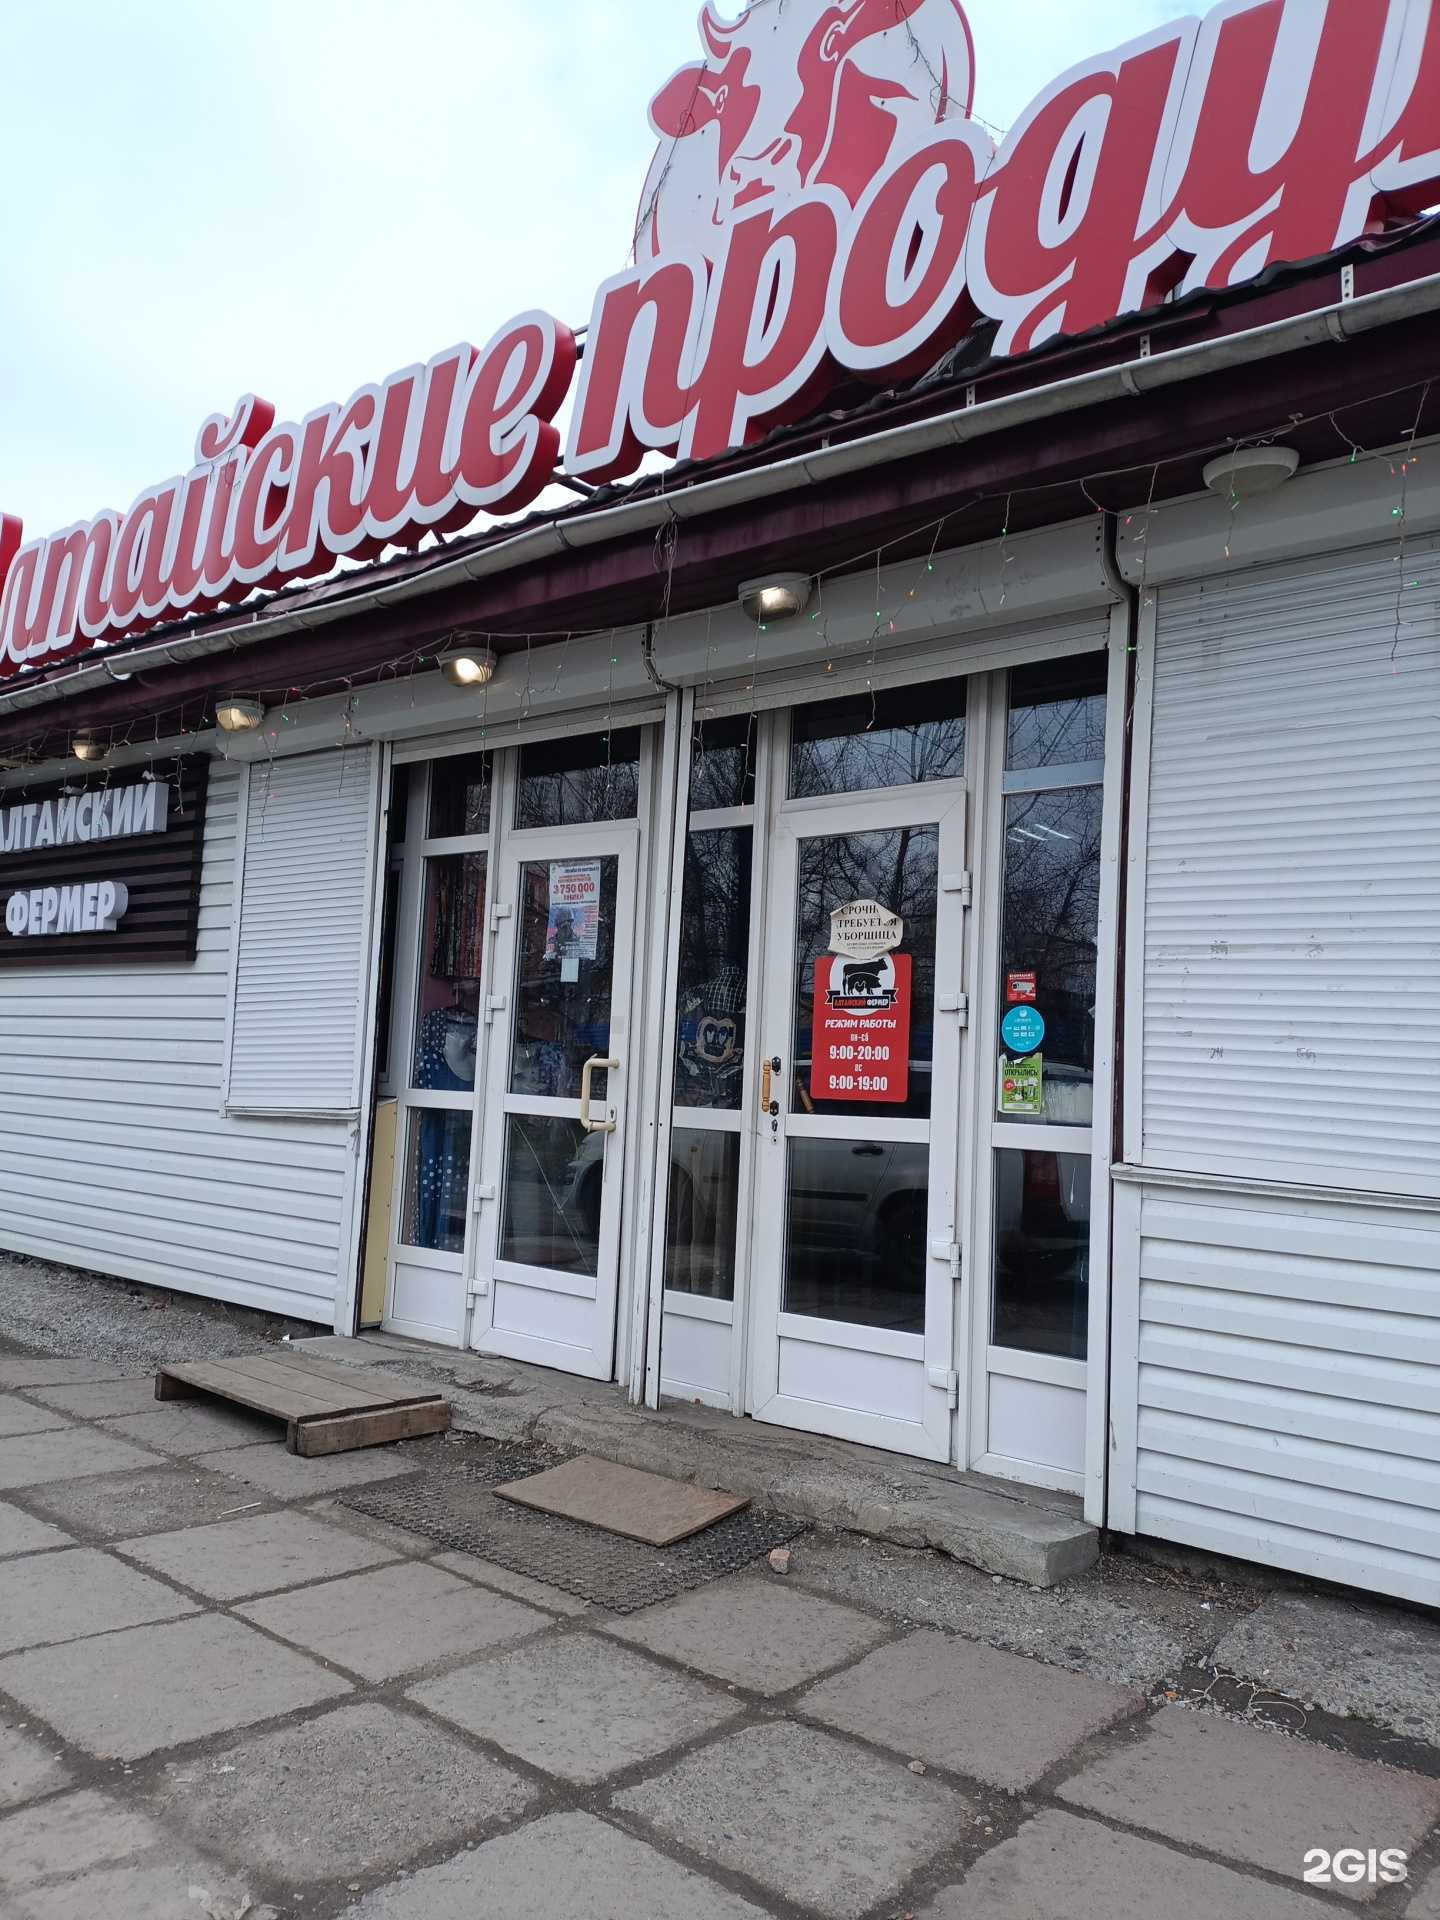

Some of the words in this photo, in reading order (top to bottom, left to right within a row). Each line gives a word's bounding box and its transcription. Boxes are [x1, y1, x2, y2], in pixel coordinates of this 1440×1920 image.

[0, 310, 572, 668] лтайские
[566, 0, 1440, 476] проду
[0, 771, 167, 853] ЛТАЙСКИЙ
[560, 884, 577, 894] 750
[577, 882, 595, 893] 000
[6, 881, 127, 936] ФЕРМЕР
[841, 904, 879, 915] СРОЧН
[837, 917, 897, 928] ТРЕБУЕТЯ
[837, 930, 897, 942] УБОРЩИЦА
[866, 997, 889, 1007] ФЕРМЕР
[824, 1019, 858, 1029] РЕЖИМ
[859, 1019, 897, 1029] РАБОТЫ
[829, 1045, 890, 1060] 9:00-20:00
[1004, 1068, 1038, 1076] ОТКРЫЛИСЬ
[828, 1075, 888, 1091] 9:00-19:00
